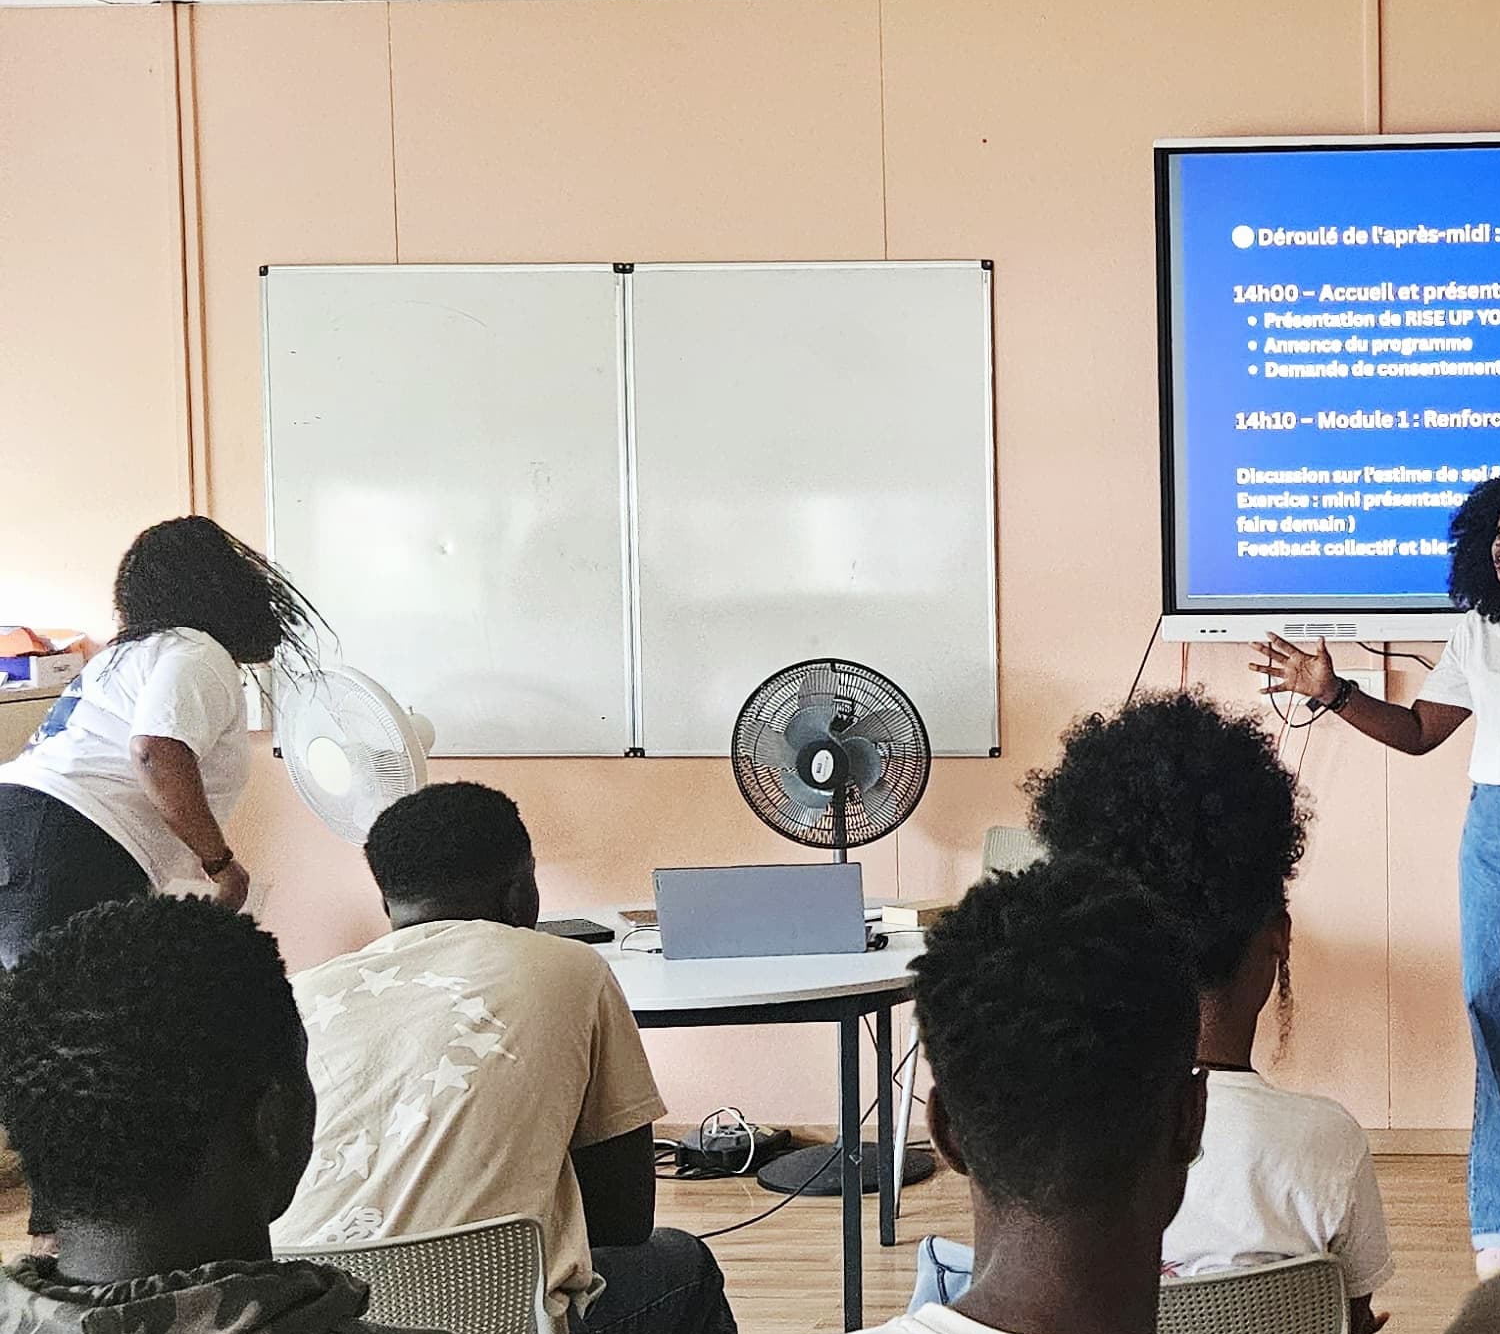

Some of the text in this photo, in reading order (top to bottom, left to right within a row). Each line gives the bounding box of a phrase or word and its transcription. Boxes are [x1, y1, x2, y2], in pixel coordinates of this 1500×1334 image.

[1258, 227, 1339, 247] Déroulé
[1342, 226, 1368, 245] de
[1372, 224, 1490, 248] l'après-midi
[1232, 284, 1299, 303] 14h00
[1318, 282, 1394, 302] Accueil
[1398, 284, 1420, 301] et
[1264, 310, 1375, 329] Présentation
[1379, 310, 1402, 327] de
[1405, 310, 1446, 326] RISE
[1449, 310, 1473, 326] UP
[1264, 335, 1473, 356] Annonce du programme
[1264, 360, 1348, 378] Demande
[1352, 360, 1374, 377] de
[1235, 411, 1296, 430] 14h10
[1318, 409, 1394, 430] Module
[1398, 411, 1410, 427] 1
[1236, 467, 1330, 485] Discussion
[1332, 469, 1362, 483] sur
[1364, 466, 1432, 483] l'estime
[1436, 465, 1458, 483] de
[1461, 465, 1488, 482] soi
[1237, 491, 1310, 509] Exercice
[1322, 491, 1360, 508] mini
[1236, 516, 1278, 533] faire
[1238, 539, 1320, 557] Feedback
[1324, 539, 1398, 557] collectif
[1398, 541, 1418, 556] et
